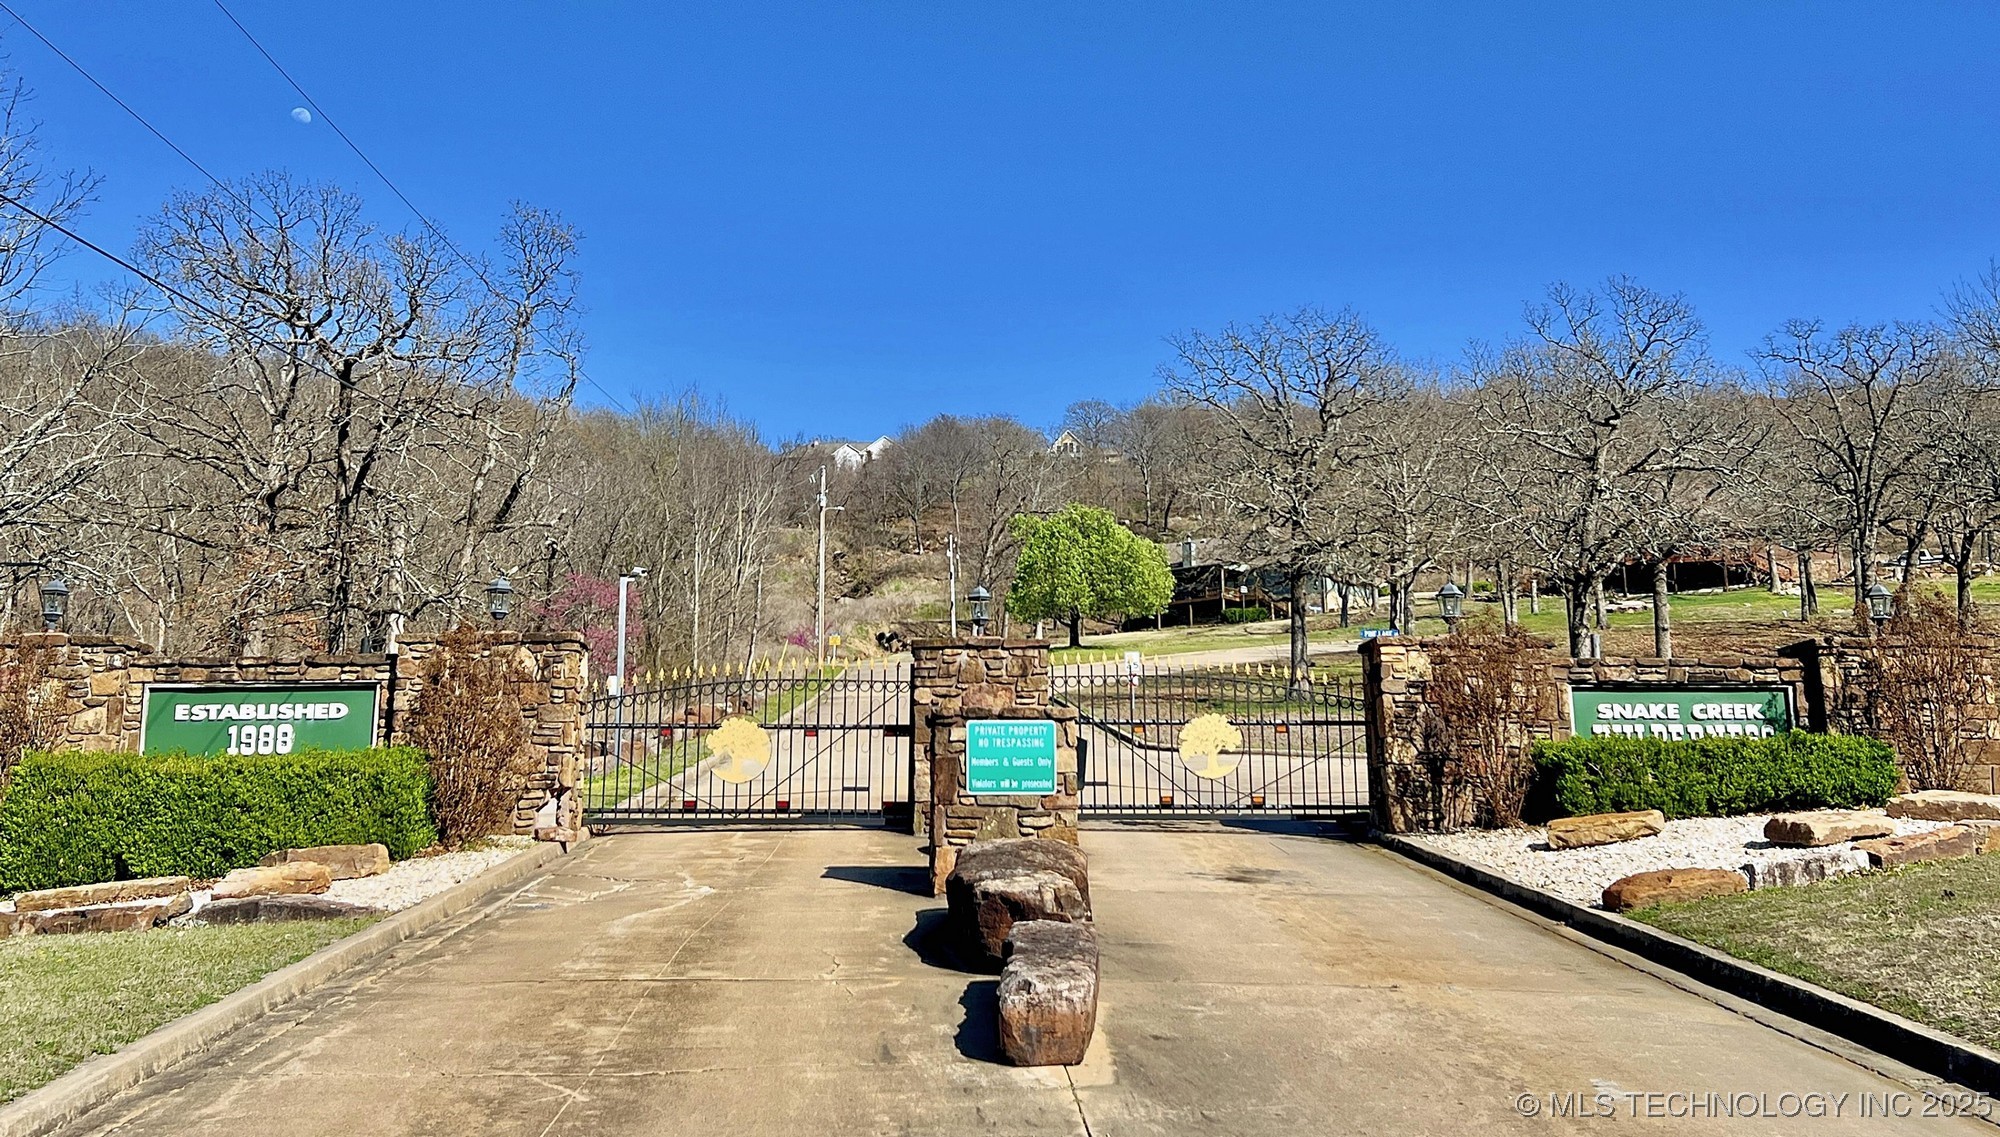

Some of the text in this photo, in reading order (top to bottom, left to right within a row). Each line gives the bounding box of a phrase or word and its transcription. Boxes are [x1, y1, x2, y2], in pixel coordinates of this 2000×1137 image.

[174, 702, 350, 721] ESTABLISHED
[1597, 703, 1765, 720] SNAKE CREEK
[974, 726, 1047, 736] PRIVATE PROPERTY
[226, 723, 296, 756] 1988
[978, 738, 1044, 748] NO TRESPASSING
[971, 757, 999, 767] Members
[1012, 757, 1034, 767] Guests
[1037, 757, 1052, 769] Only
[1000, 779, 1010, 788] will
[1010, 779, 1018, 788] be
